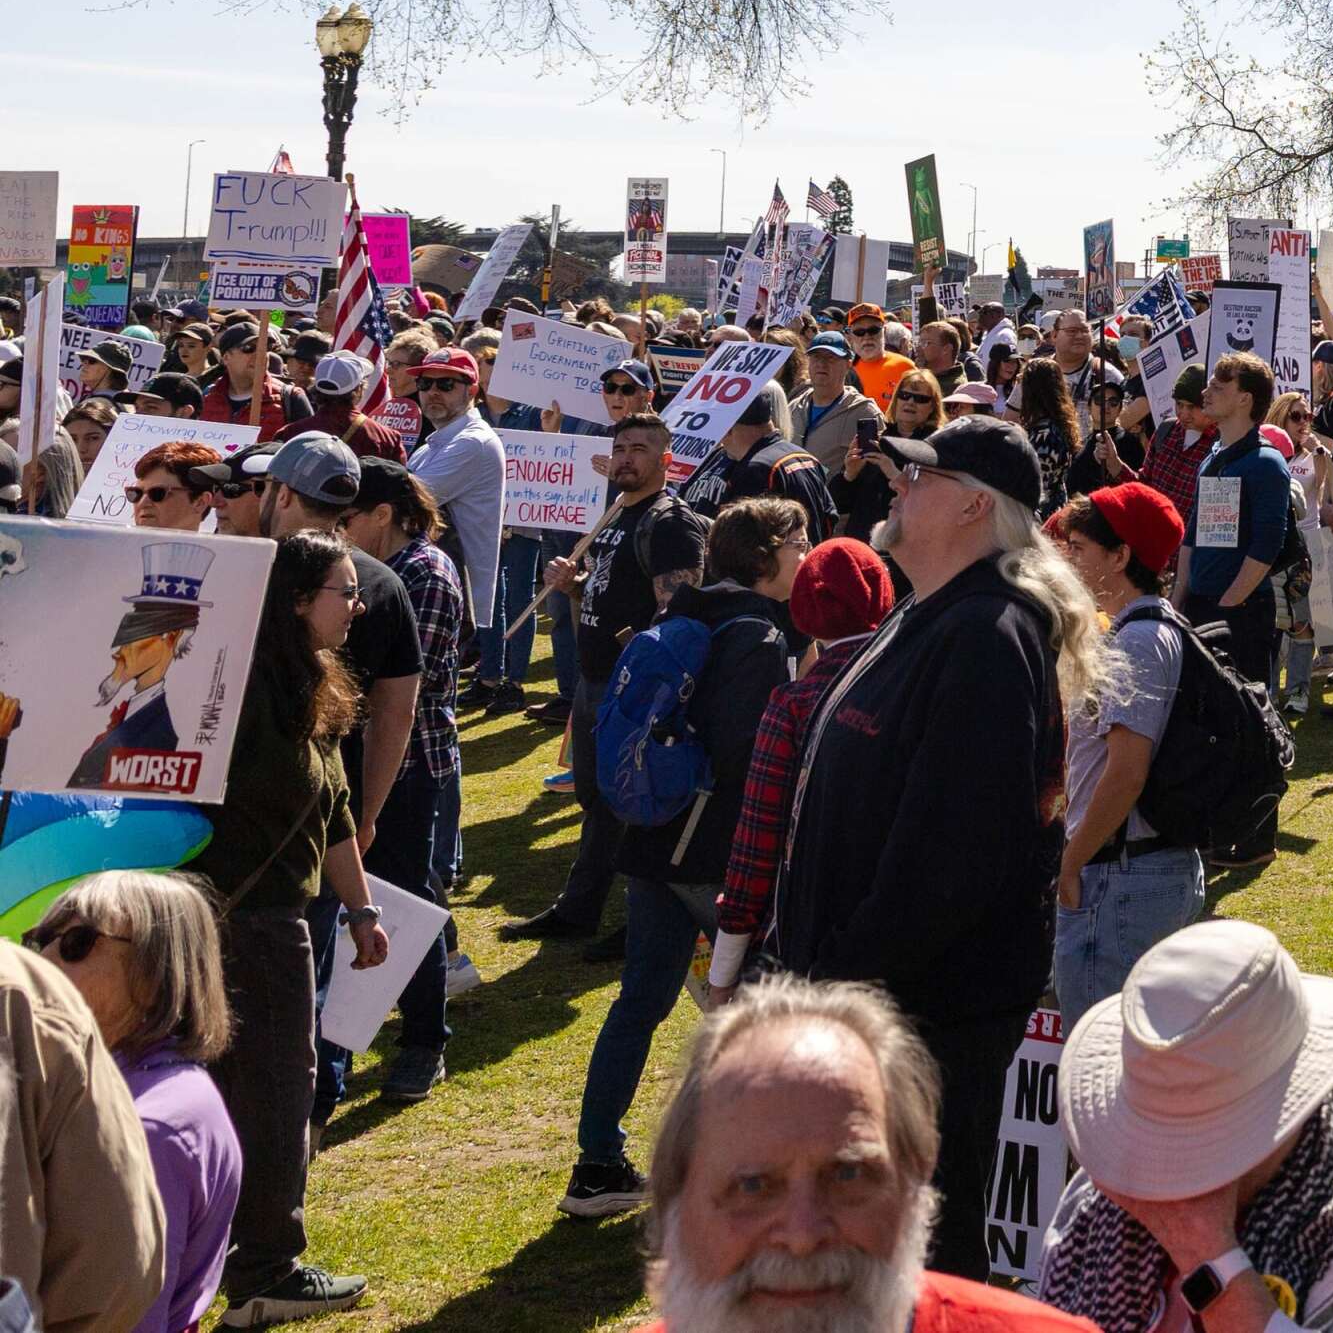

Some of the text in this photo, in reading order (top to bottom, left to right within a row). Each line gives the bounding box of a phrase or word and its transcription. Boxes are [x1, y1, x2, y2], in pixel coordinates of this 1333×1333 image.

[215, 176, 314, 209] FUCK
[74, 227, 129, 244] NO KINGS
[1182, 257, 1220, 269] REVOKE
[1184, 268, 1223, 281] THE ICE
[218, 274, 277, 288] ICE OUT OF
[215, 287, 275, 300] PORTLAND
[1047, 290, 1065, 299] THE
[547, 331, 599, 357] GRIFTING
[711, 345, 783, 376] WE SAY
[1272, 355, 1300, 382] AND
[511, 362, 537, 377] HAS
[542, 369, 569, 383] GOT
[574, 376, 588, 390] TO
[685, 375, 752, 404] NO
[384, 402, 412, 416] PRO-
[122, 417, 233, 441] Showing our
[674, 411, 711, 431] TO
[554, 442, 577, 461] not
[505, 458, 574, 487] ENOUGH
[518, 502, 588, 525] OUTRAGE
[108, 753, 199, 788] WORST
